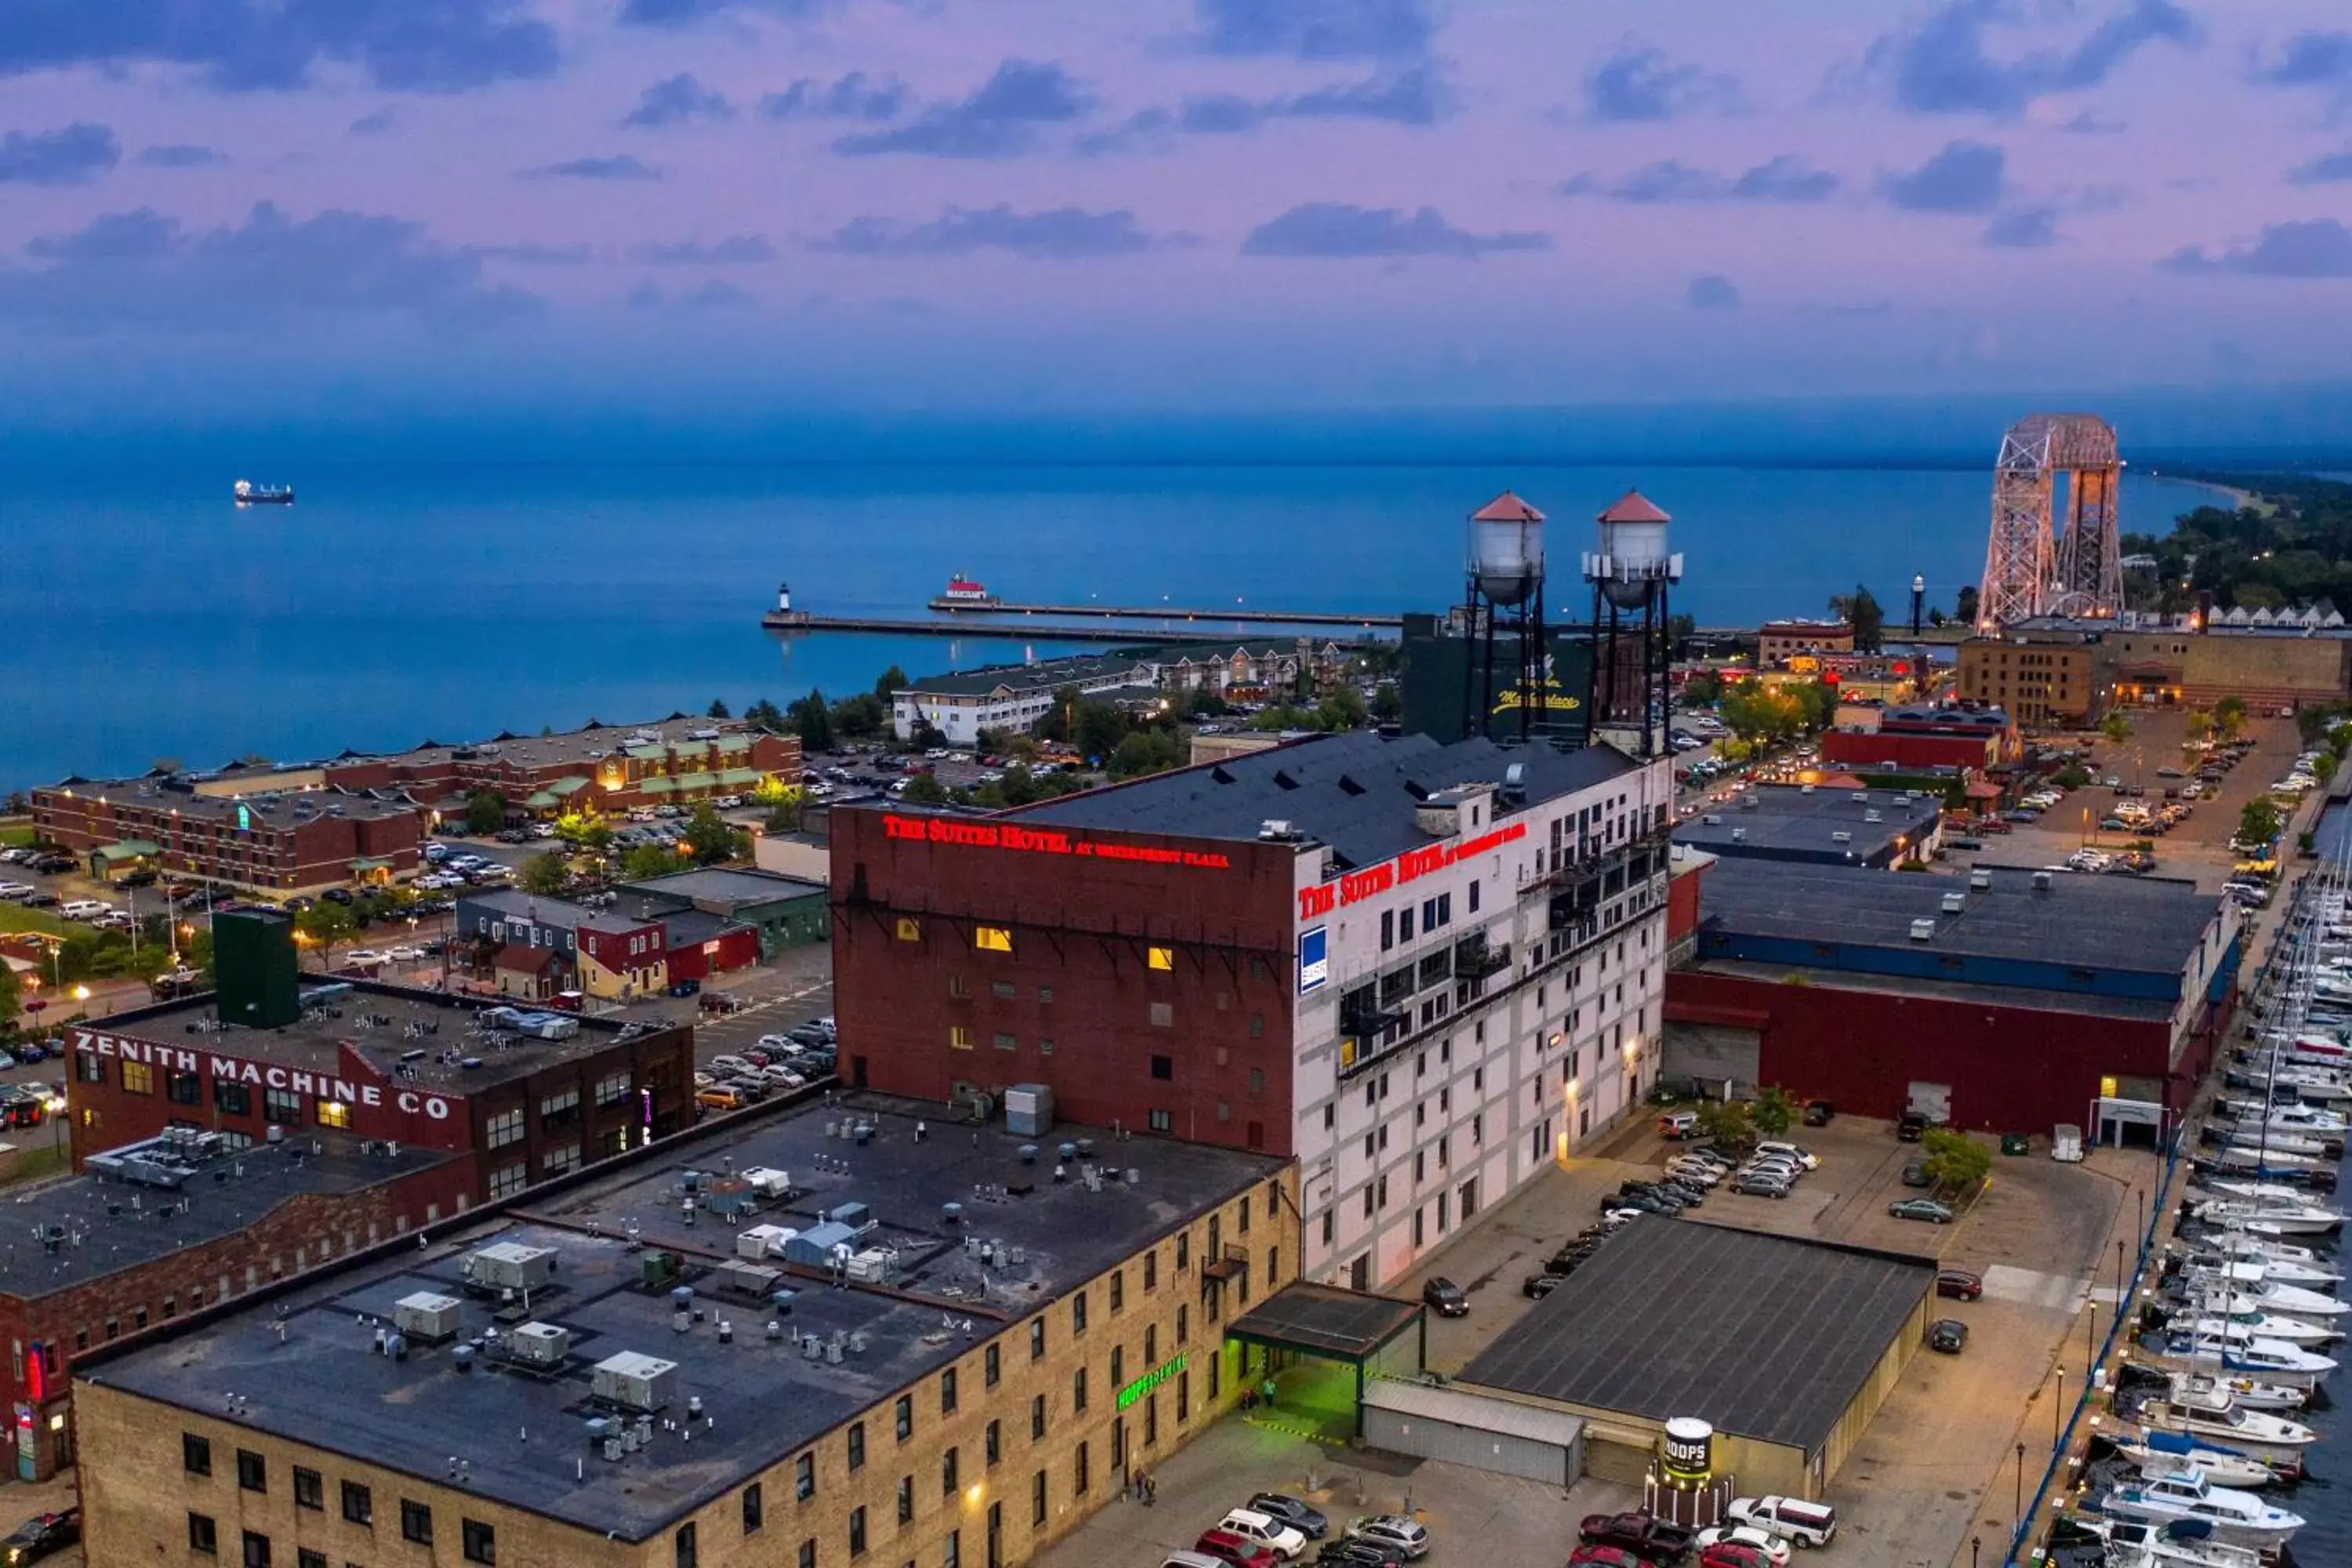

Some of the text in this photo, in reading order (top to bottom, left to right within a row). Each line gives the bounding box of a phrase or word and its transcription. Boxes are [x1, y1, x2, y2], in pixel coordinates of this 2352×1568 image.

[883, 815, 926, 840] THE
[929, 819, 998, 846] SUITES
[1000, 826, 1071, 854] HOTEL
[1298, 883, 1335, 920] THE
[75, 1032, 448, 1120] ZENITH MACHINE CO
